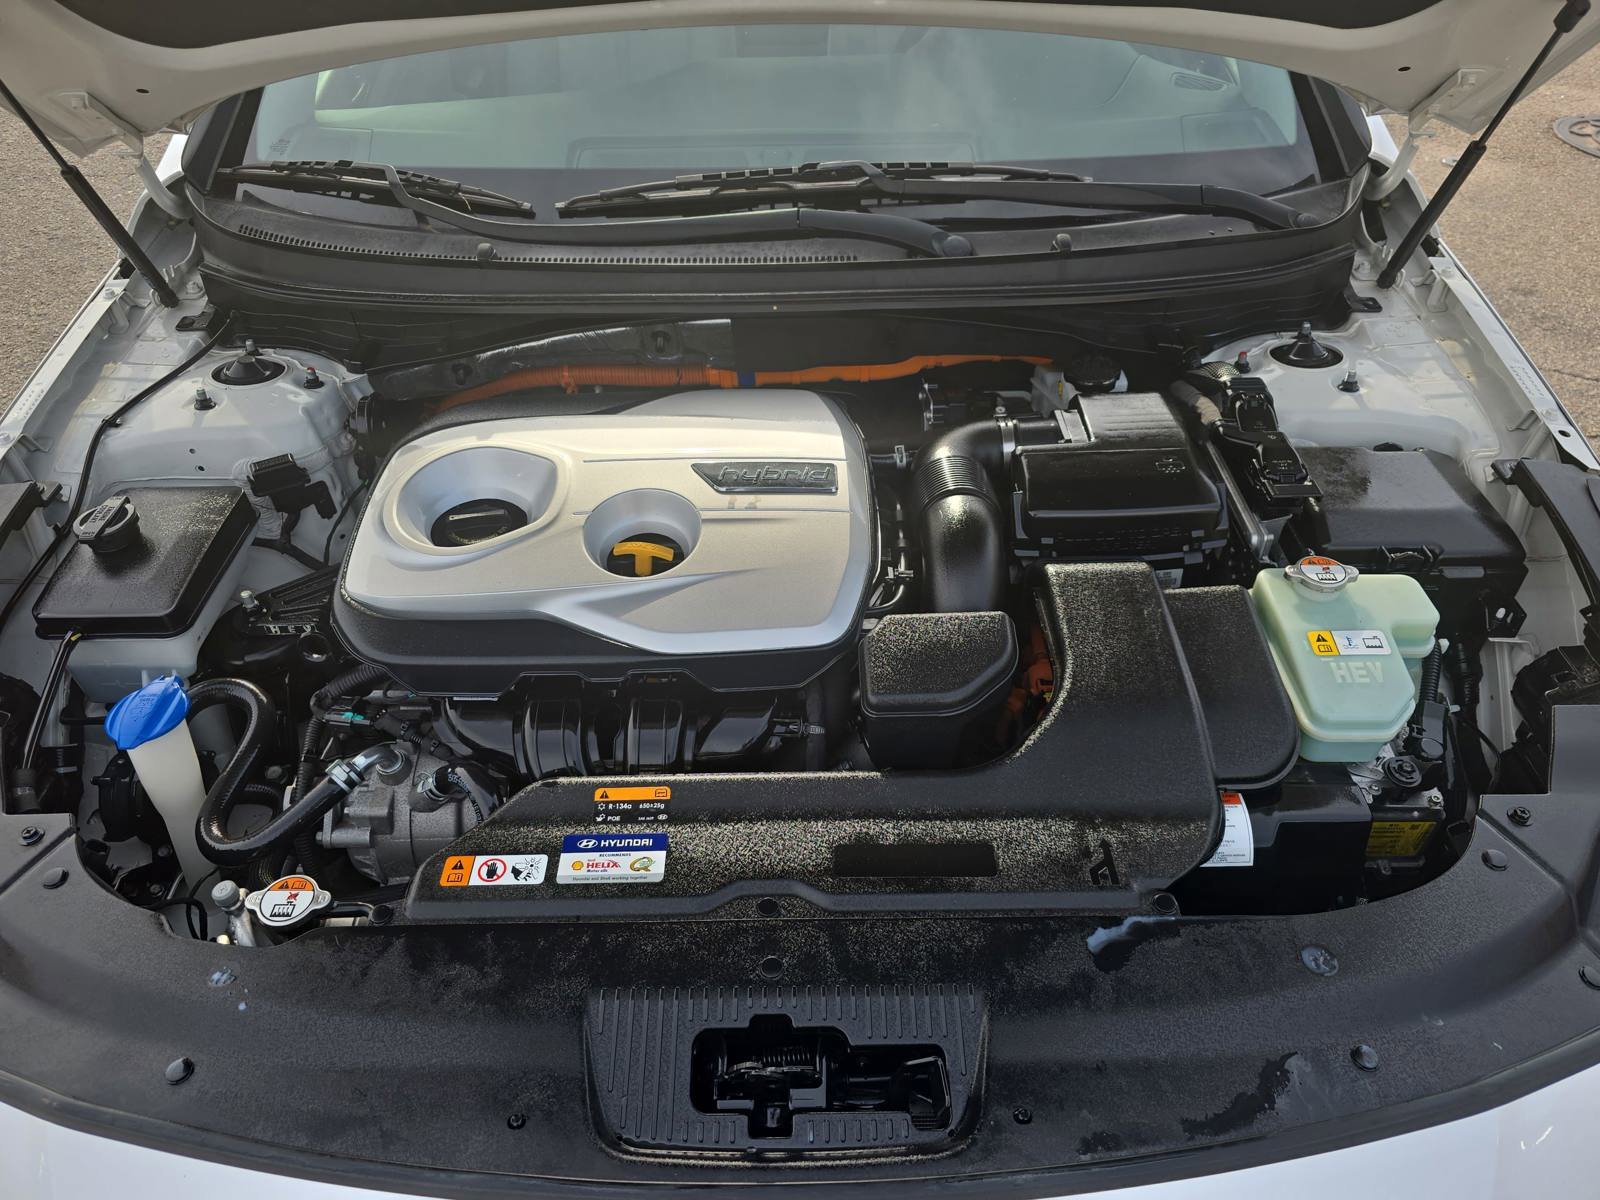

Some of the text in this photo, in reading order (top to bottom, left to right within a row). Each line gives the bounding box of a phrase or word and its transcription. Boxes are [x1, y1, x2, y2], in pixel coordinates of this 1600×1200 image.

[718, 466, 831, 485] hybrid
[1330, 662, 1384, 683] HEV
[600, 839, 653, 848] HYUNDAI
[586, 860, 620, 869] HELIX
